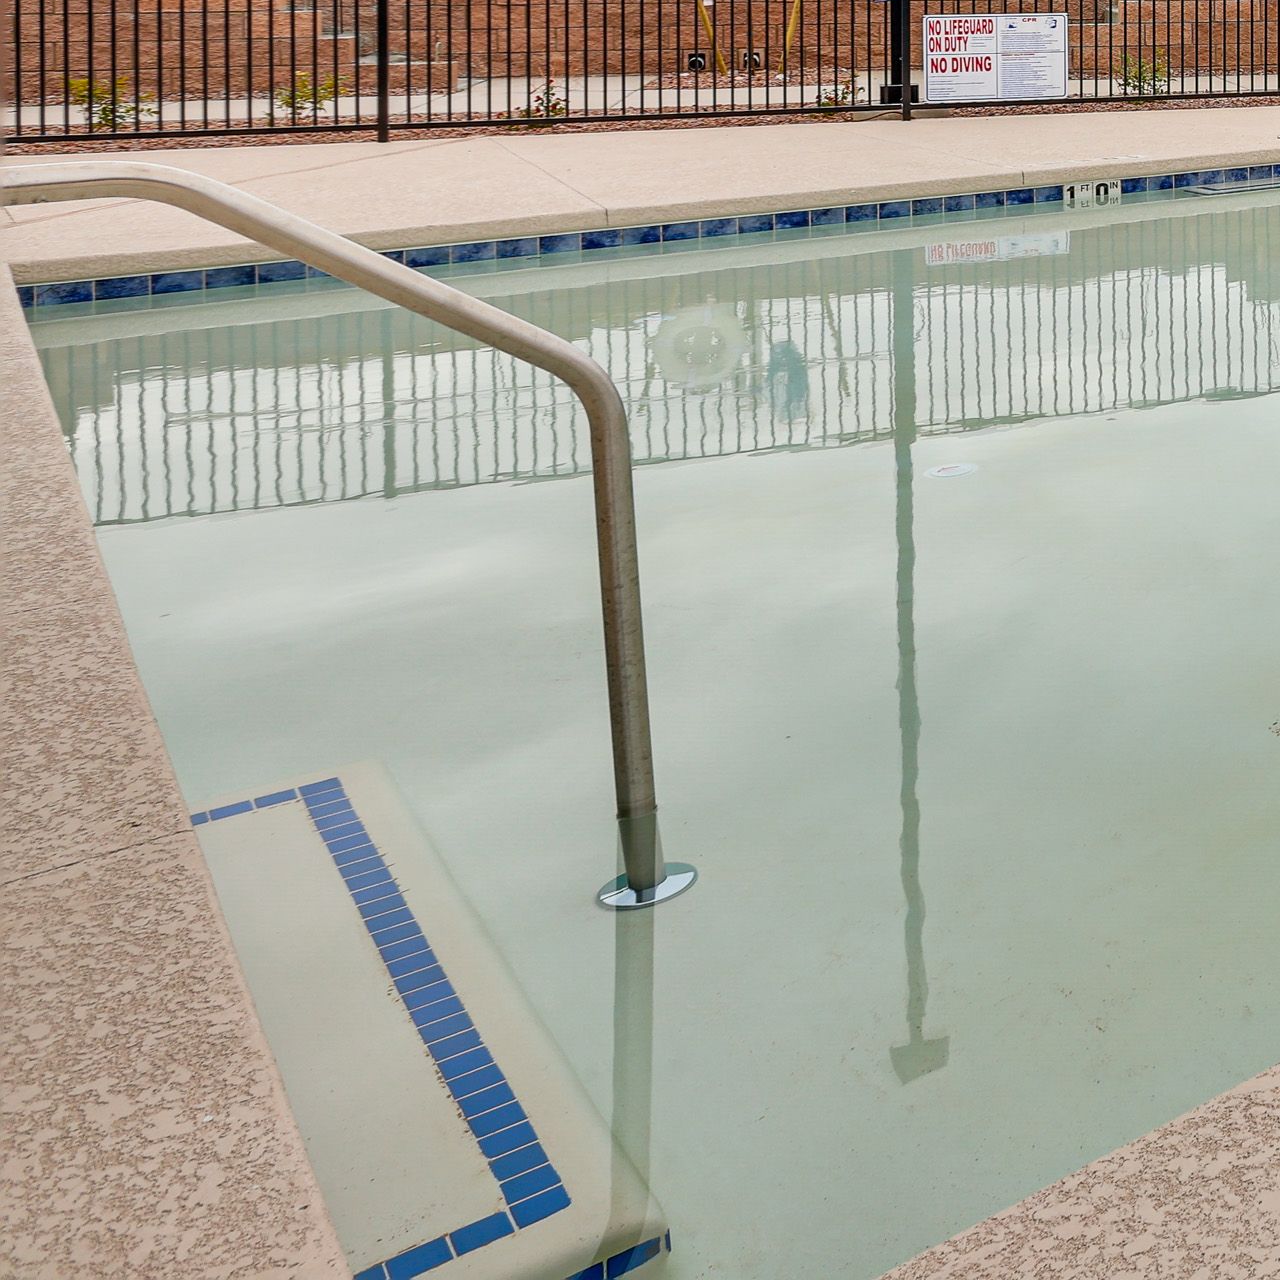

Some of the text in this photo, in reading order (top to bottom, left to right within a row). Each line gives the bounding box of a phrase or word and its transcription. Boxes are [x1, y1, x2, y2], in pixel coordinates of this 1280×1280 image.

[928, 19, 994, 36] NO LIFEGUARD
[929, 37, 941, 52] ON
[944, 36, 968, 52] DUTY
[931, 56, 992, 73] NO DIVING
[1066, 186, 1075, 202] 1
[1080, 184, 1090, 192] FT
